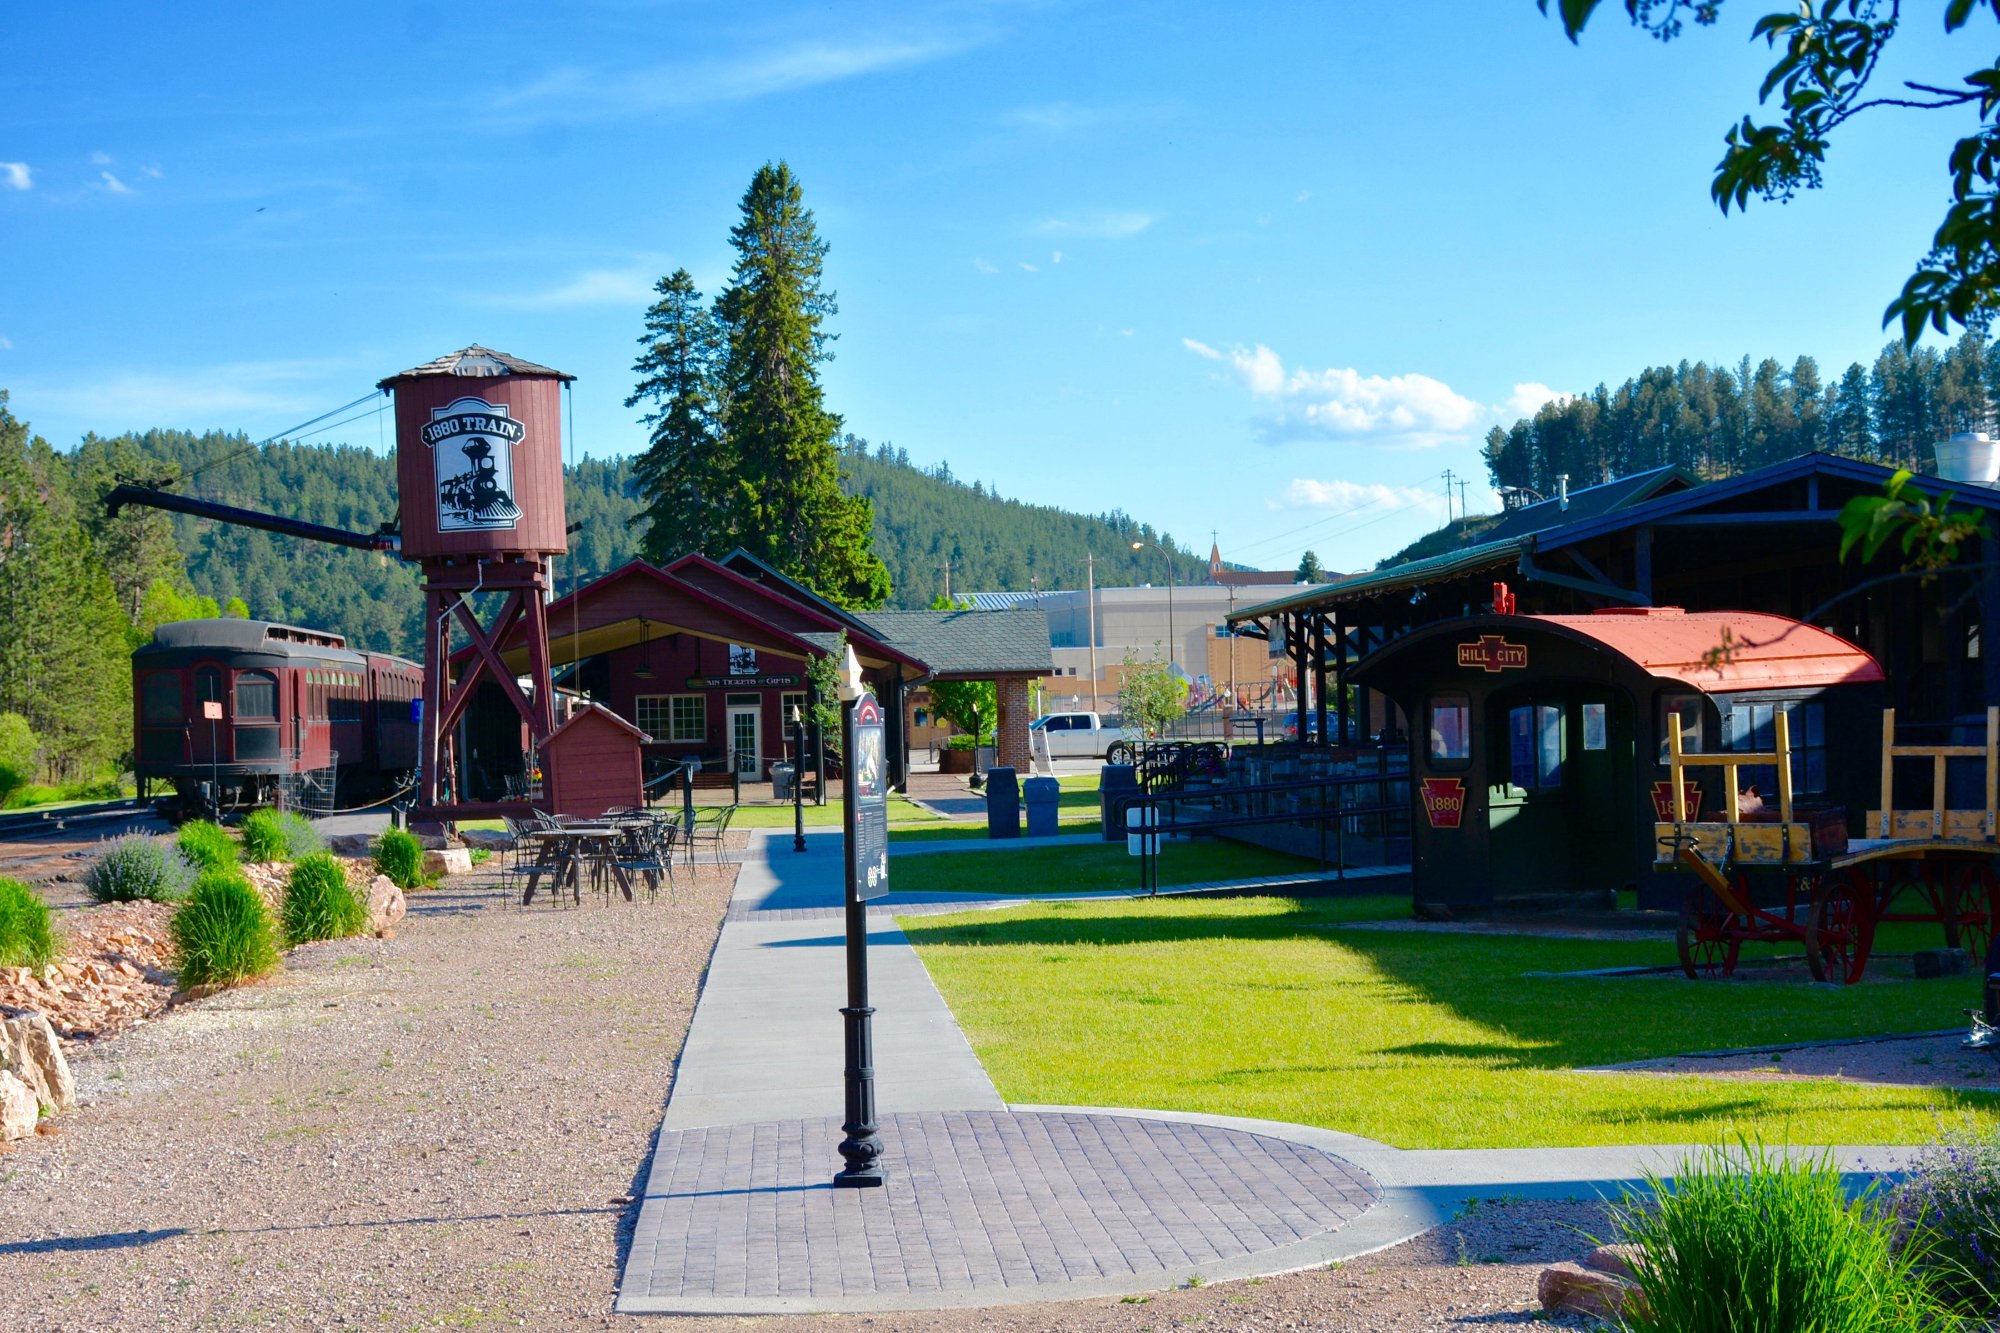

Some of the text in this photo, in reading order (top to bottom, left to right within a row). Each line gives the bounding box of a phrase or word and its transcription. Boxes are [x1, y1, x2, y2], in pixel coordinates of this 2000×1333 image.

[428, 416, 517, 441] 1880 TRAIN
[1461, 649, 1523, 662] HILL CITY
[1430, 797, 1460, 811] 1880
[1660, 800, 1694, 815] 180
